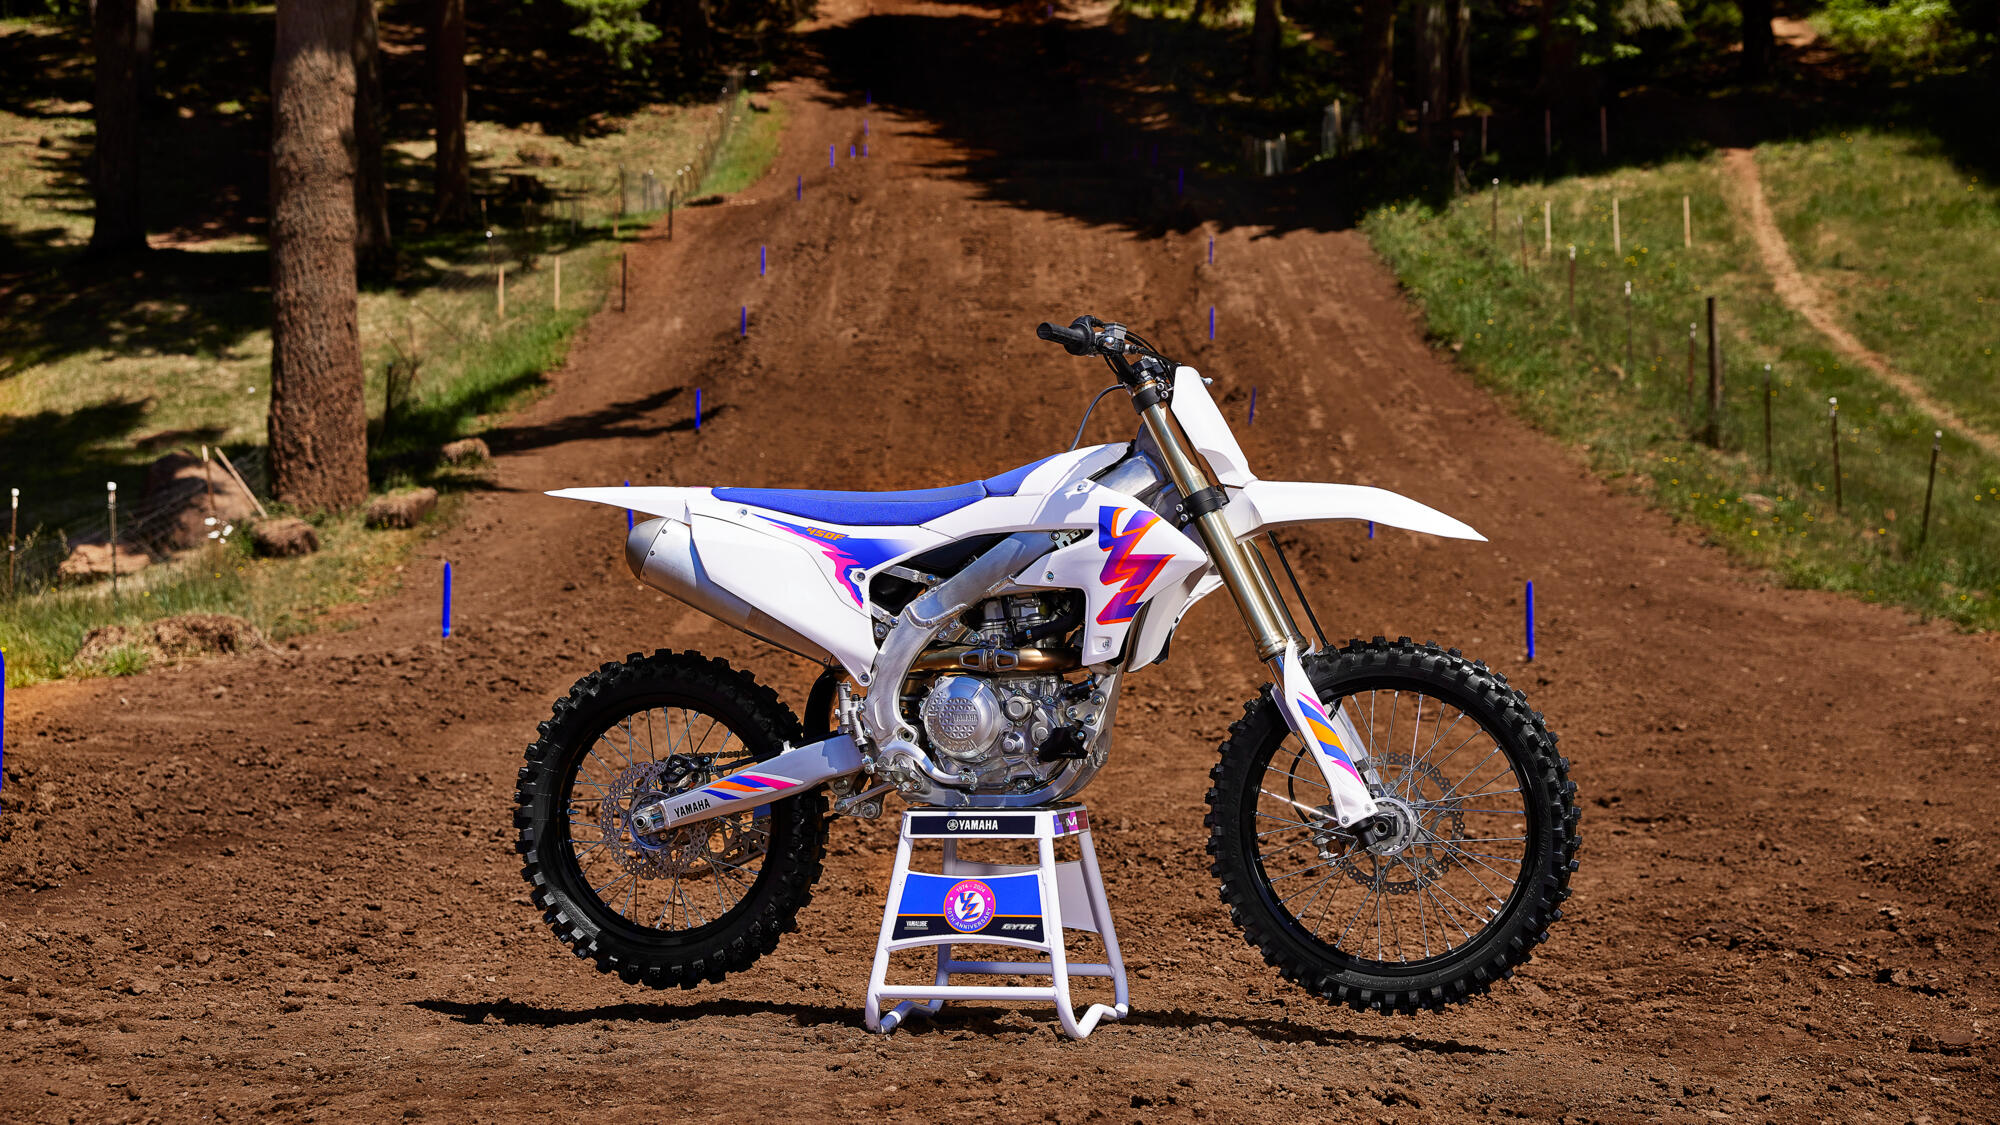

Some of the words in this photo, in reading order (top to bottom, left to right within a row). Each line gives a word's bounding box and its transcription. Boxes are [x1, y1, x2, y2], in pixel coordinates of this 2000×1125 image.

[806, 527, 846, 541] 450F
[674, 798, 711, 818] YAMAHA
[959, 819, 998, 831] YAMAHA
[956, 884, 968, 893] 1974
[973, 884, 986, 893] 2024
[955, 907, 992, 930] ANNIVERSARY
[1001, 923, 1037, 931] GYTR
